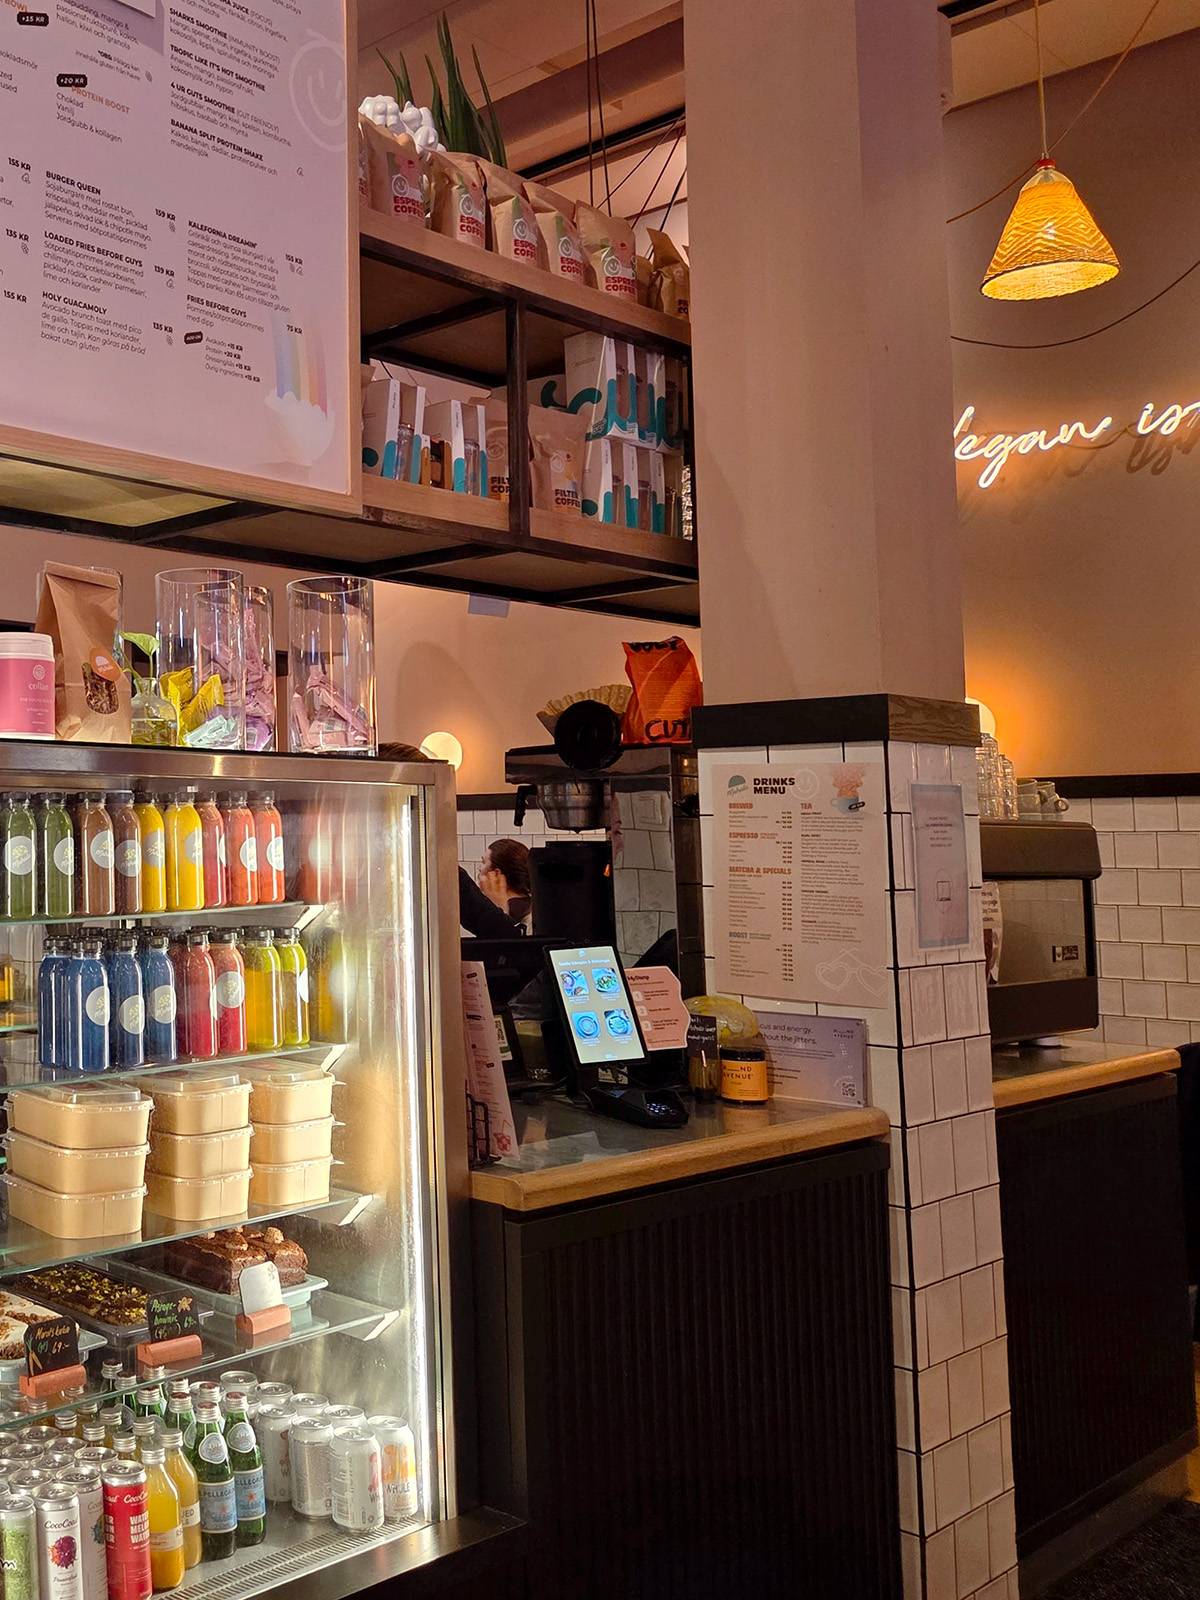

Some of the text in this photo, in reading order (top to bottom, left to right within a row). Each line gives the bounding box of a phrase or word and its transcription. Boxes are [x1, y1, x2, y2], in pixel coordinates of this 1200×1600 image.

[36, 16, 46, 24] KR
[75, 77, 85, 85] KR
[70, 85, 130, 114] PROTEIN BOOST
[8, 157, 31, 171] 155 KR
[45, 171, 101, 195] BURGER QUEEN
[393, 196, 423, 210] ESPRE
[155, 208, 176, 221] 159 KR
[394, 205, 425, 219] COFFE
[5, 229, 29, 241] 135 KR
[44, 230, 143, 267] LOADED FRIES BEFORE GUYS
[154, 265, 175, 277] 139 KR
[3, 290, 27, 303] 155 KR
[42, 291, 62, 302] HOLY
[152, 322, 174, 333] 135 KR
[555, 489, 578, 499] FILTER
[753, 778, 795, 786] DRINKS
[753, 787, 786, 795] MENU
[729, 866, 754, 874] MATCHA
[787, 1026, 813, 1034] energy.
[130, 1510, 149, 1525] WATE
[44, 1518, 78, 1530] CocoCoa
[130, 1521, 149, 1535] MELO
[130, 1530, 150, 1543] WATE
